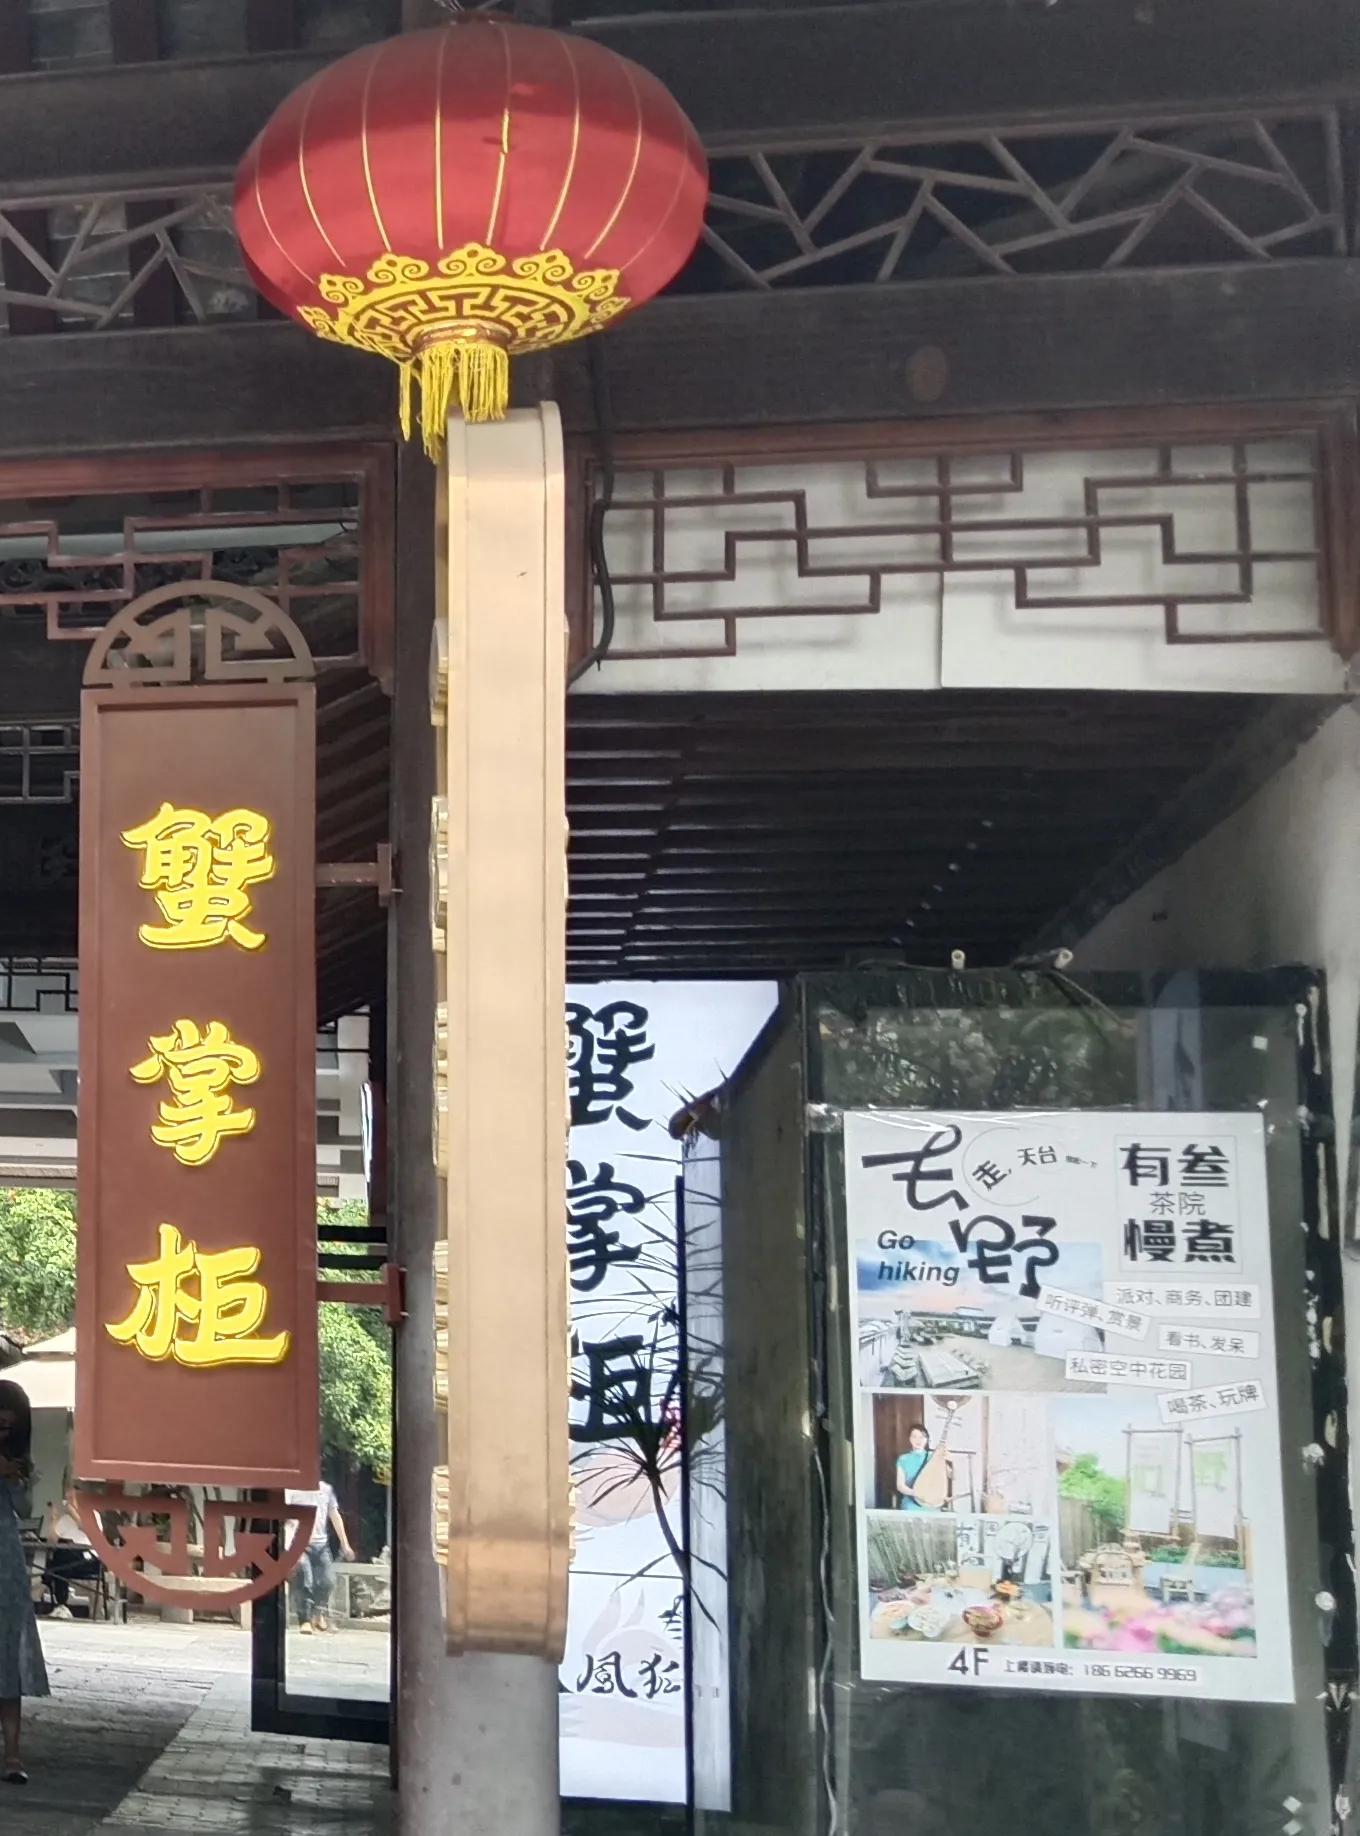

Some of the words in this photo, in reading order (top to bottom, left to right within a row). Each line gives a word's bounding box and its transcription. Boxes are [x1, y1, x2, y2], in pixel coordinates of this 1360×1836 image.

[105, 802, 290, 1365] 蟹掌柜
[1017, 1145, 1057, 1166] 天台
[1150, 1191, 1207, 1216] 茶院
[878, 1229, 915, 1252] Go
[1124, 1218, 1237, 1264] 慢煮
[878, 1261, 960, 1287] hiking
[1070, 1356, 1188, 1381] 私密空中花园
[947, 1646, 989, 1676] 4F
